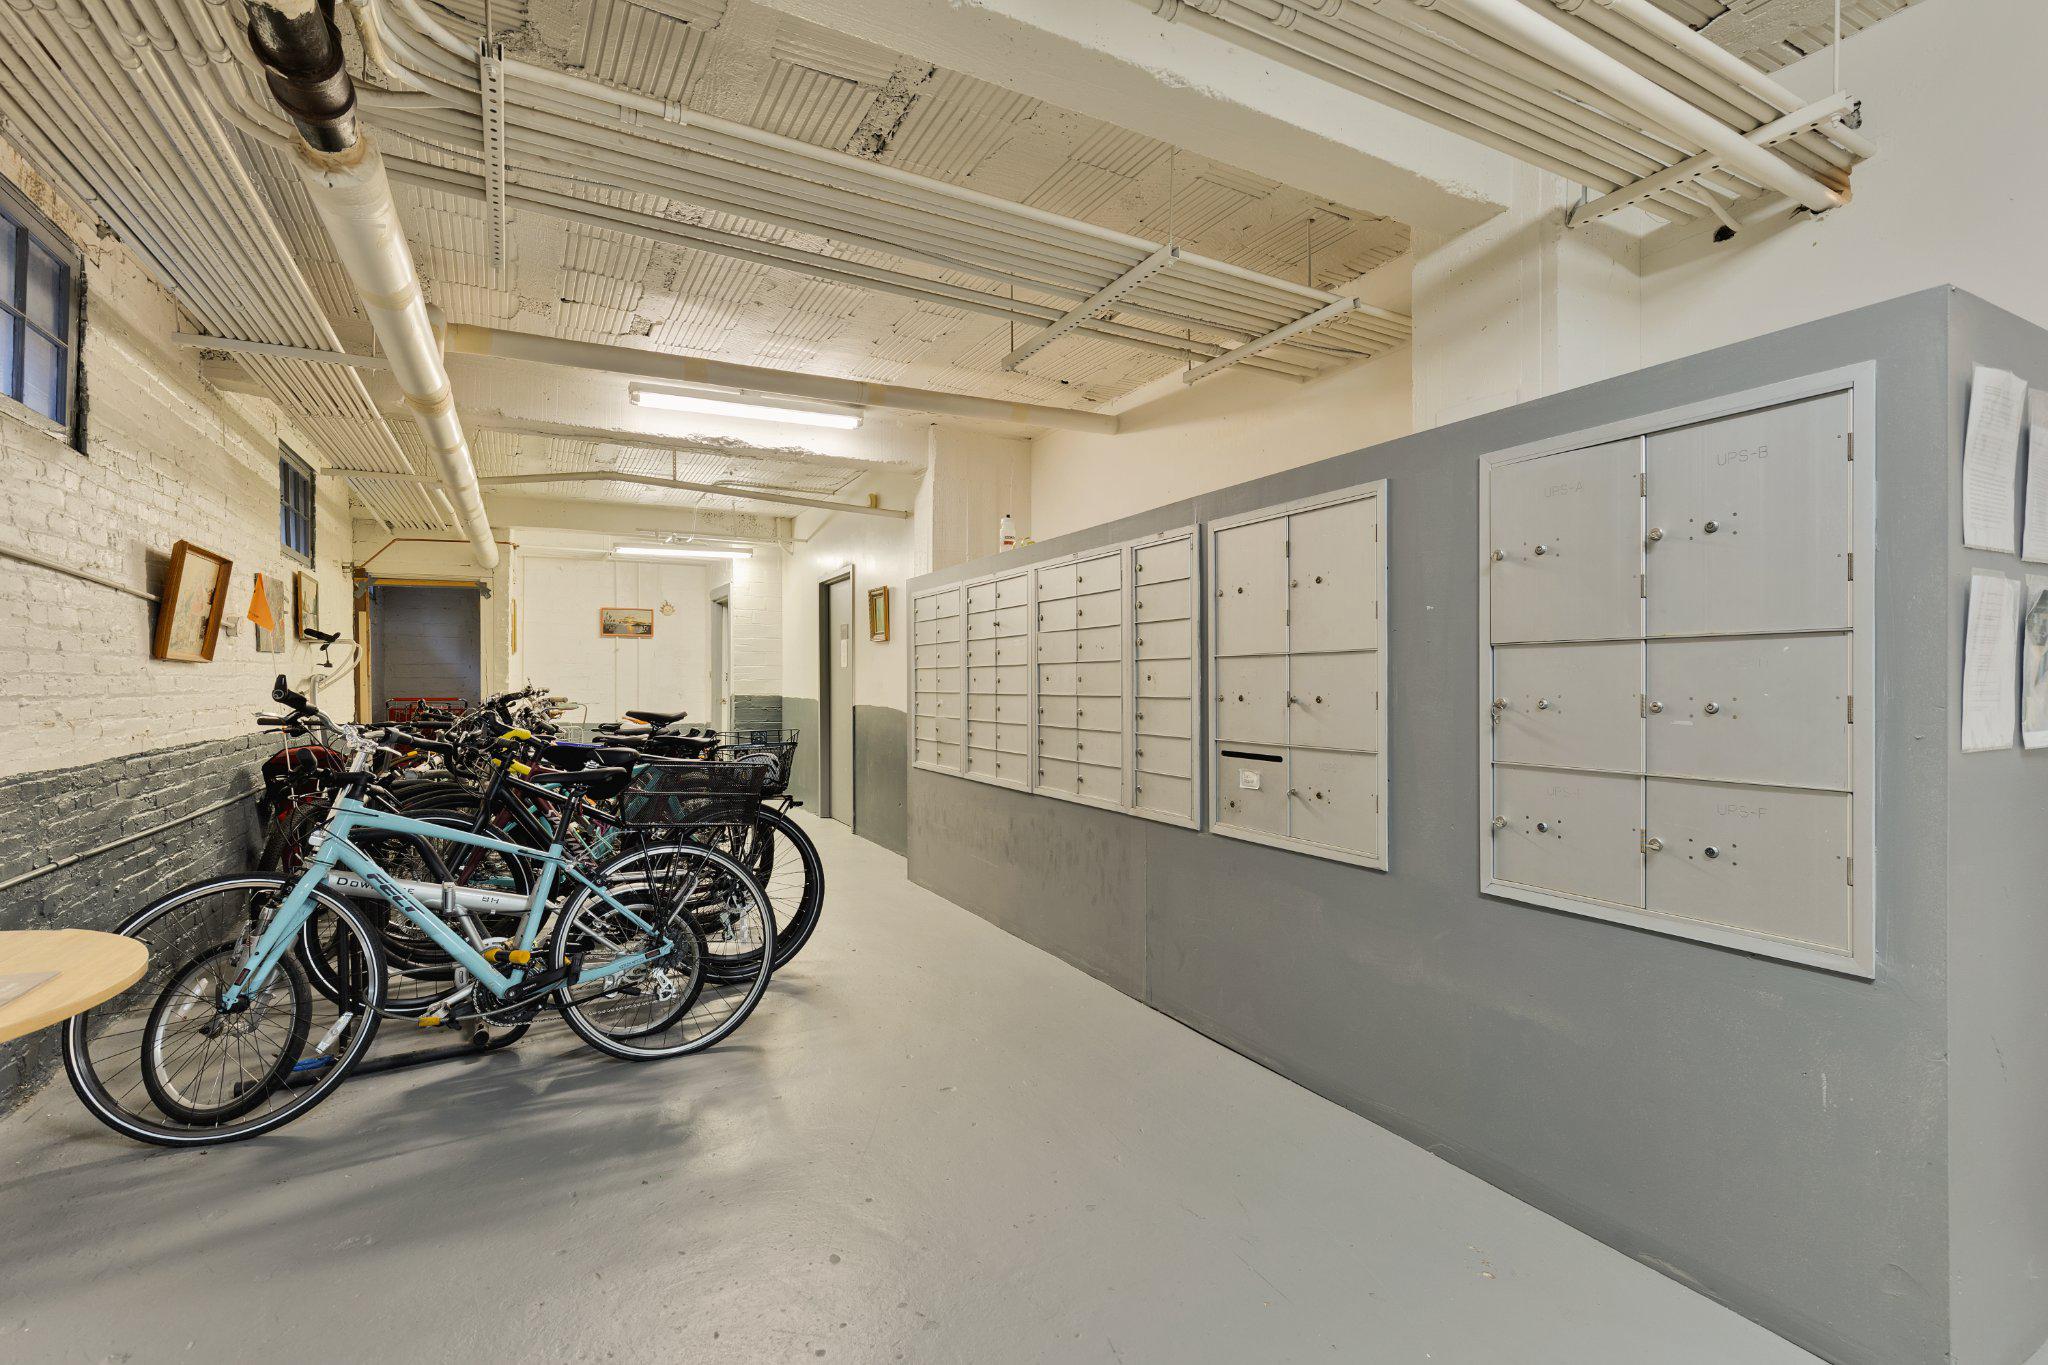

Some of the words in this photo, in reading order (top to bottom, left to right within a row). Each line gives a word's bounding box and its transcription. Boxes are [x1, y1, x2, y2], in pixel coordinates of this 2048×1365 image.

[1716, 445, 1769, 466] UPS-B
[1717, 804, 1768, 819] UPS-F
[366, 873, 425, 914] FELT
